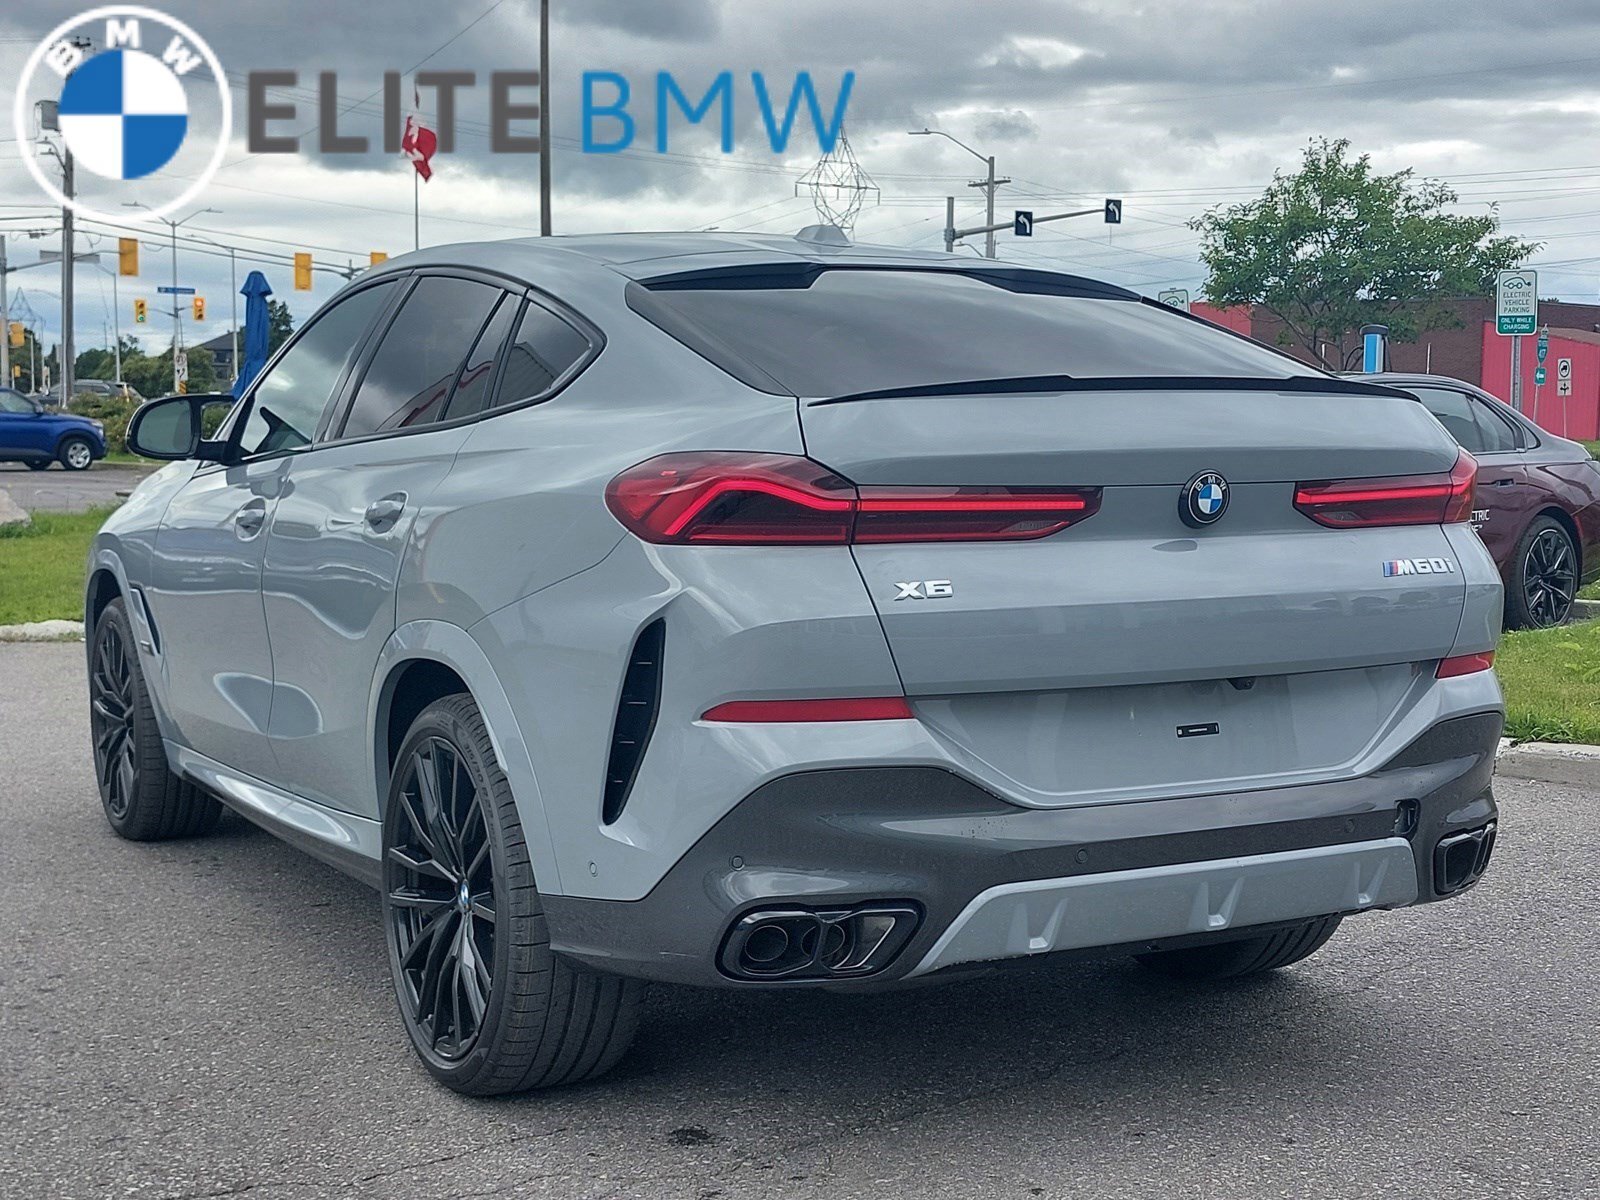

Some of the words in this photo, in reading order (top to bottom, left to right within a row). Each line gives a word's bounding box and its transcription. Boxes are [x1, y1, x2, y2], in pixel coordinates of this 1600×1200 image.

[1504, 306, 1530, 314] PARKING
[1195, 475, 1227, 491] BMW
[1396, 558, 1454, 576] M60i
[894, 580, 953, 601] X6
